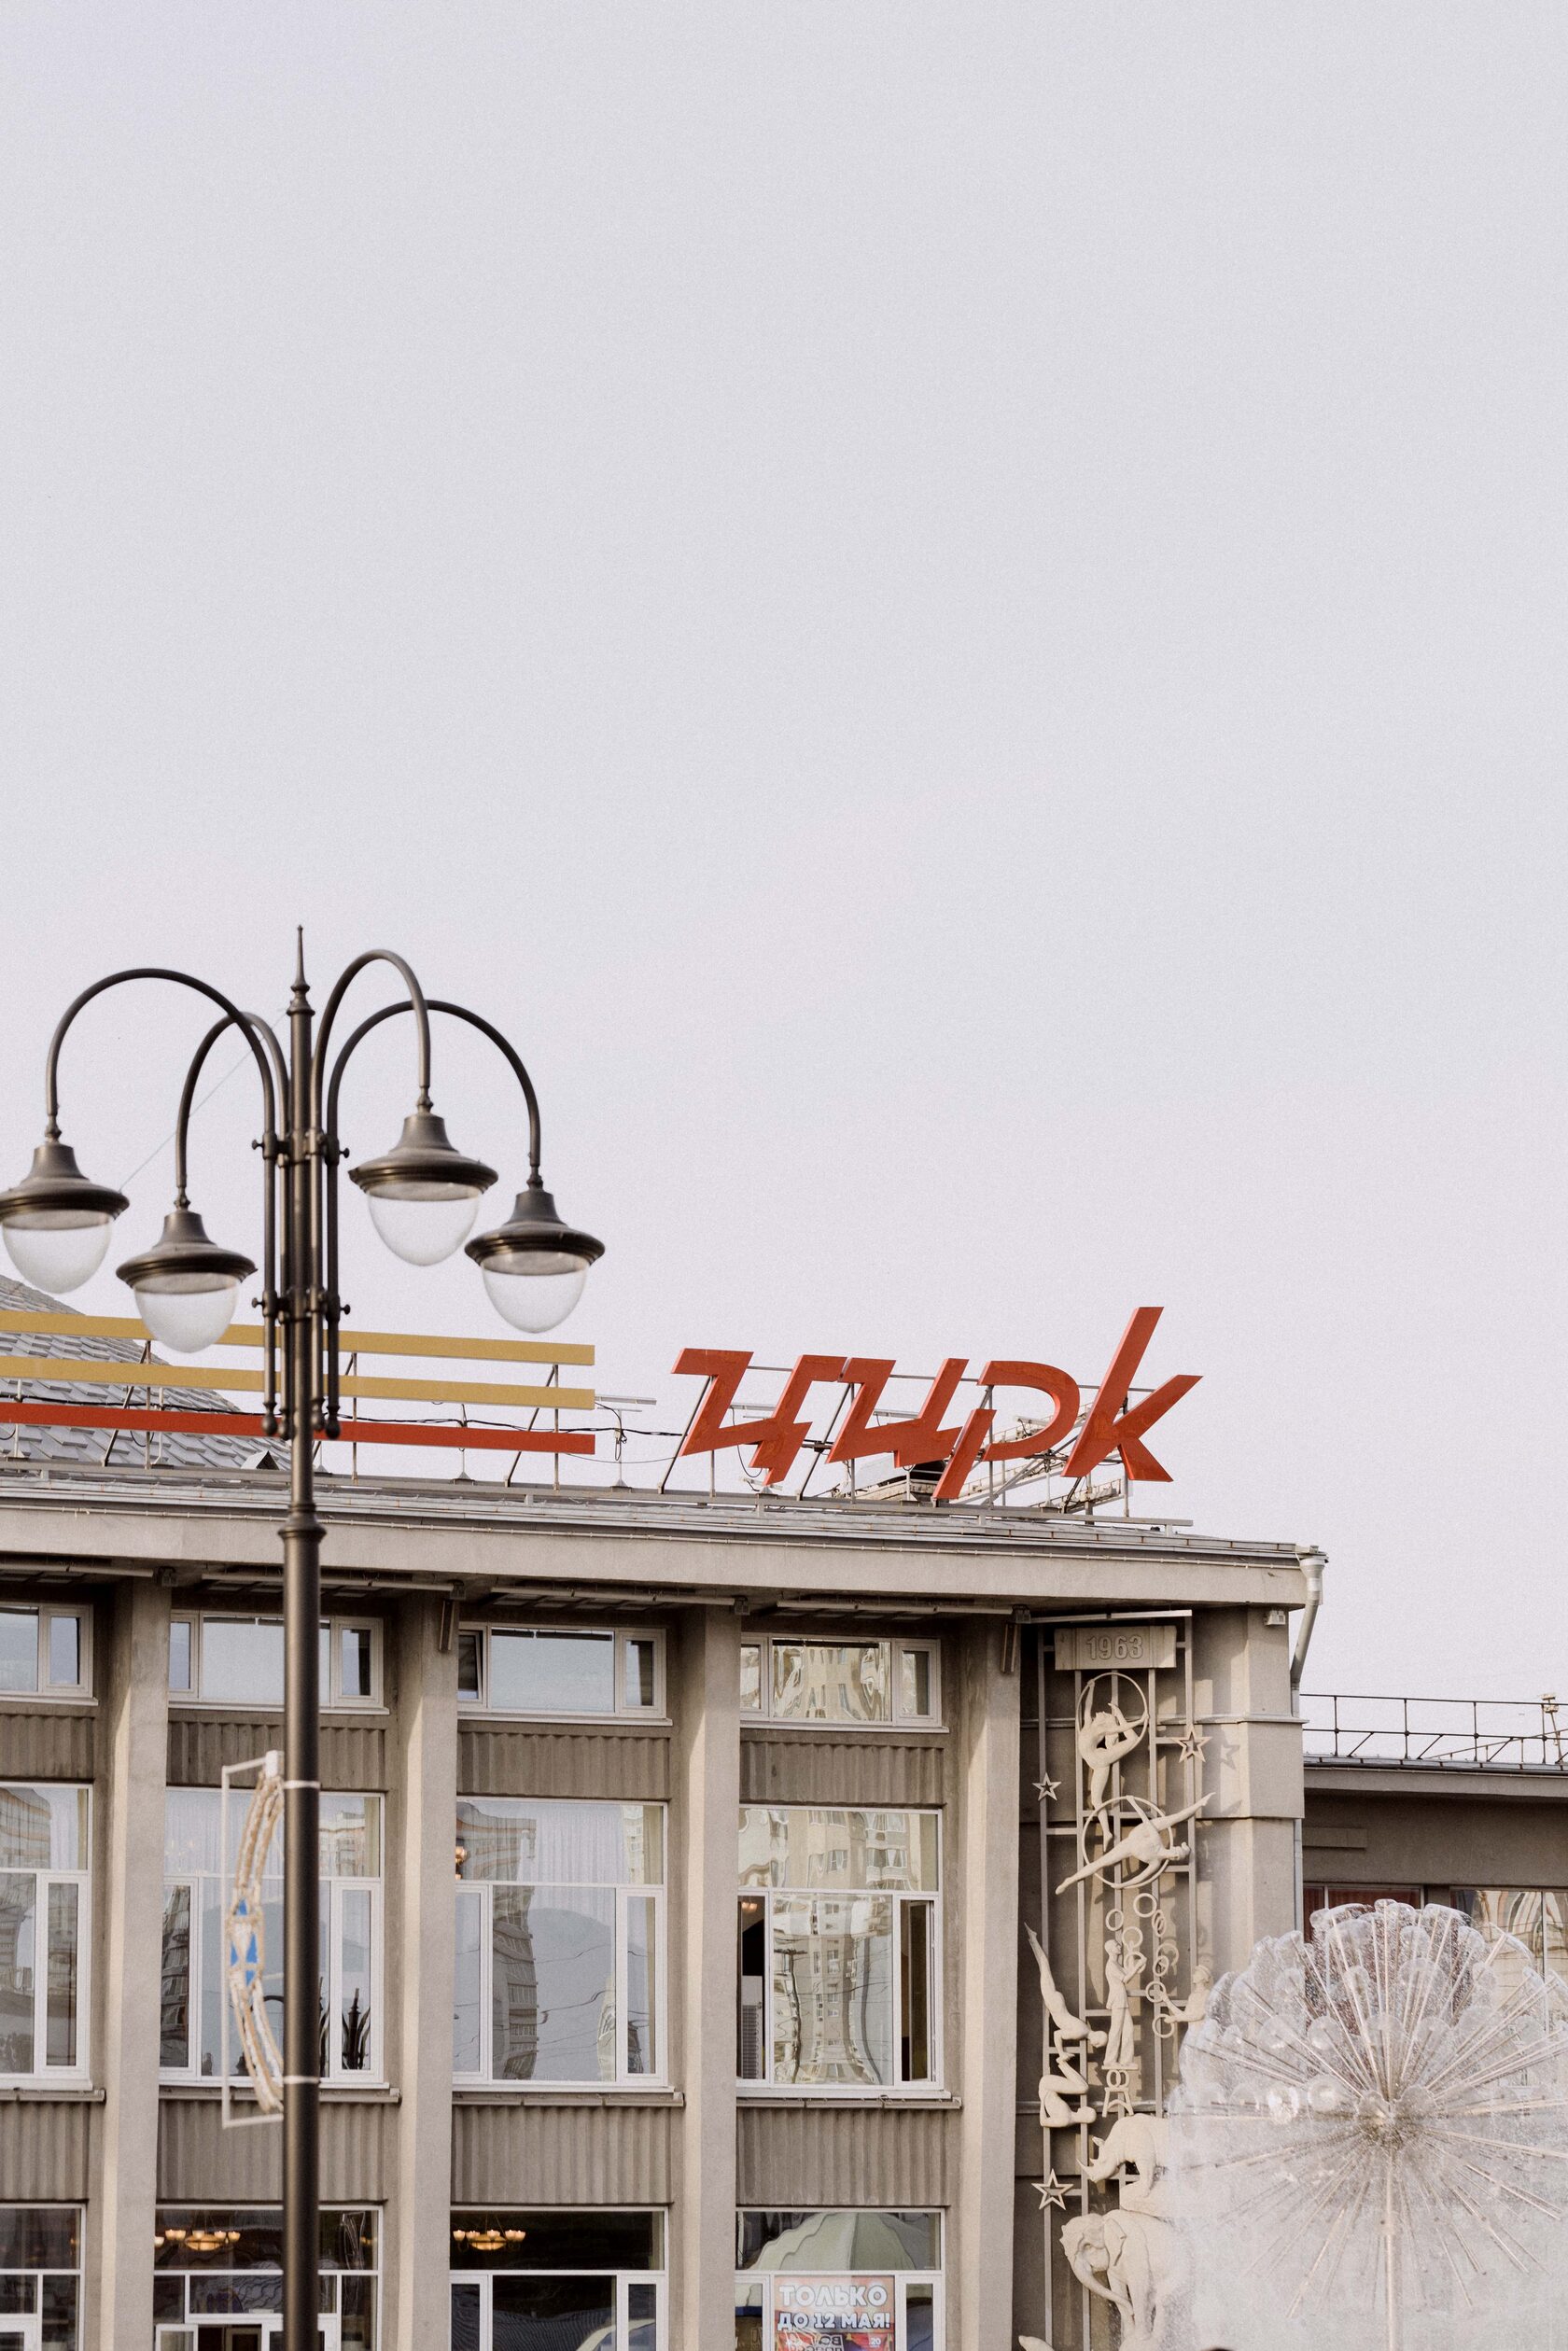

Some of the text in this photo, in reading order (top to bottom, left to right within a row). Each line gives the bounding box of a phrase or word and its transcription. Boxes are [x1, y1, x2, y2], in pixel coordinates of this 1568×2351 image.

[1085, 1635, 1143, 1660] 1963
[778, 2285, 888, 2307] ТОЛЬКО
[777, 2312, 891, 2331] ДО 12 МАЯ!
